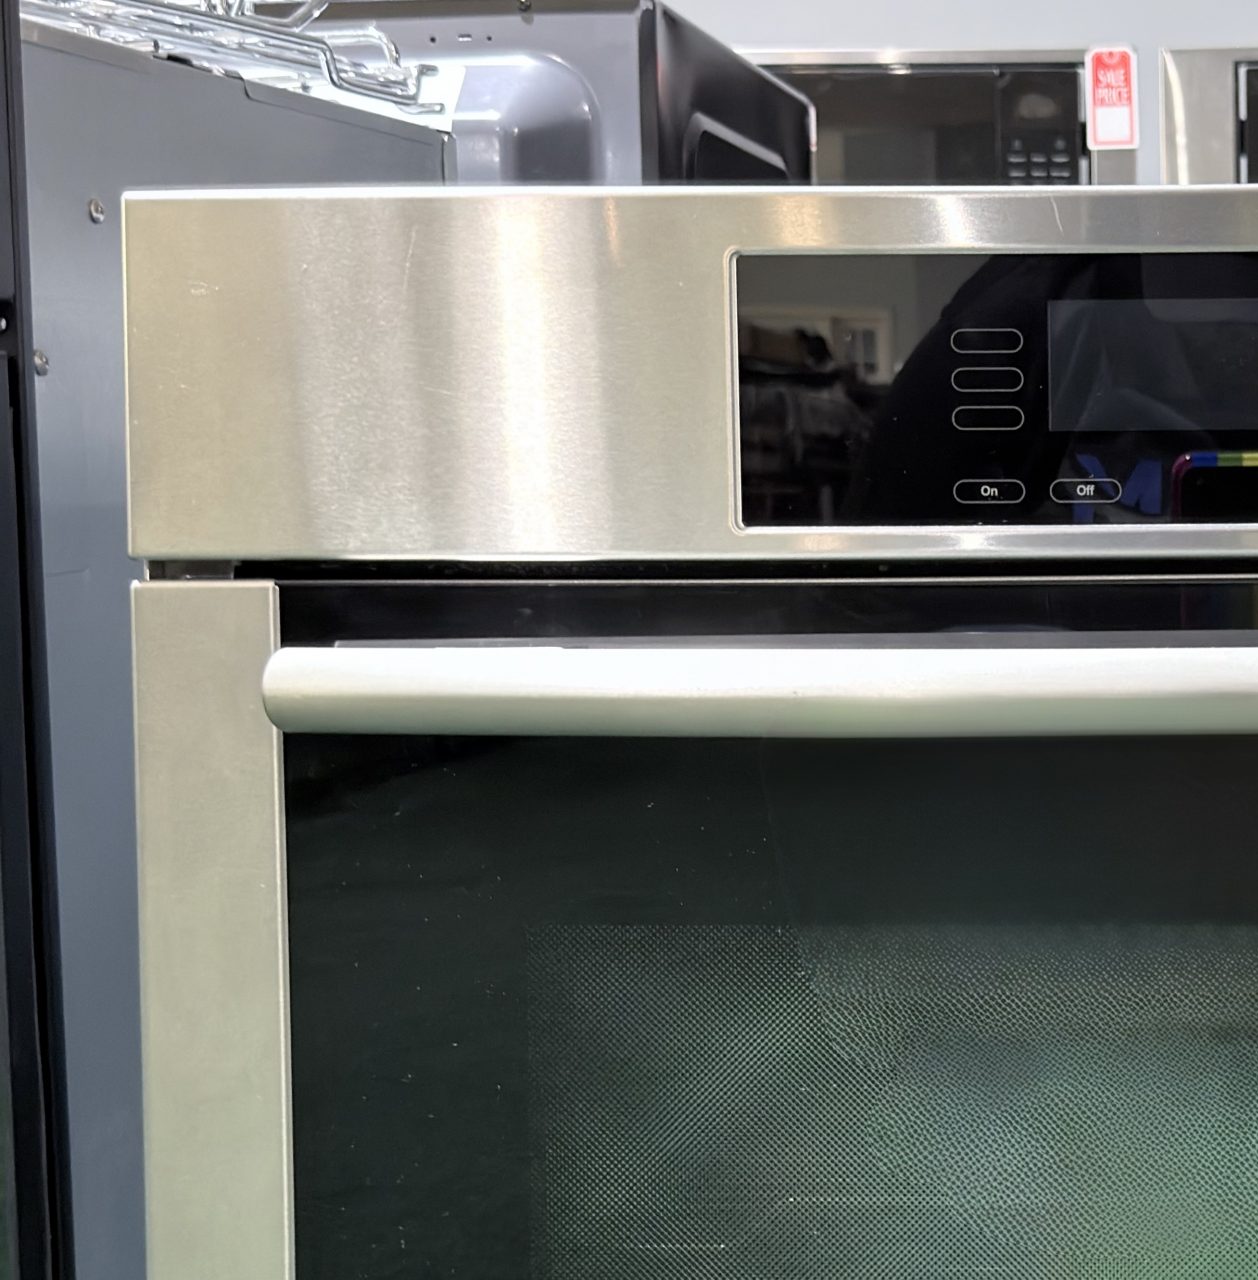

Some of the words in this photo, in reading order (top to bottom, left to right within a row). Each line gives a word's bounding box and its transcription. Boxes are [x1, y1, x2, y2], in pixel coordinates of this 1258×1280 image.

[1097, 69, 1126, 87] SALE
[1096, 88, 1129, 104] PRICE
[980, 485, 999, 497] On
[1076, 484, 1095, 496] Off
